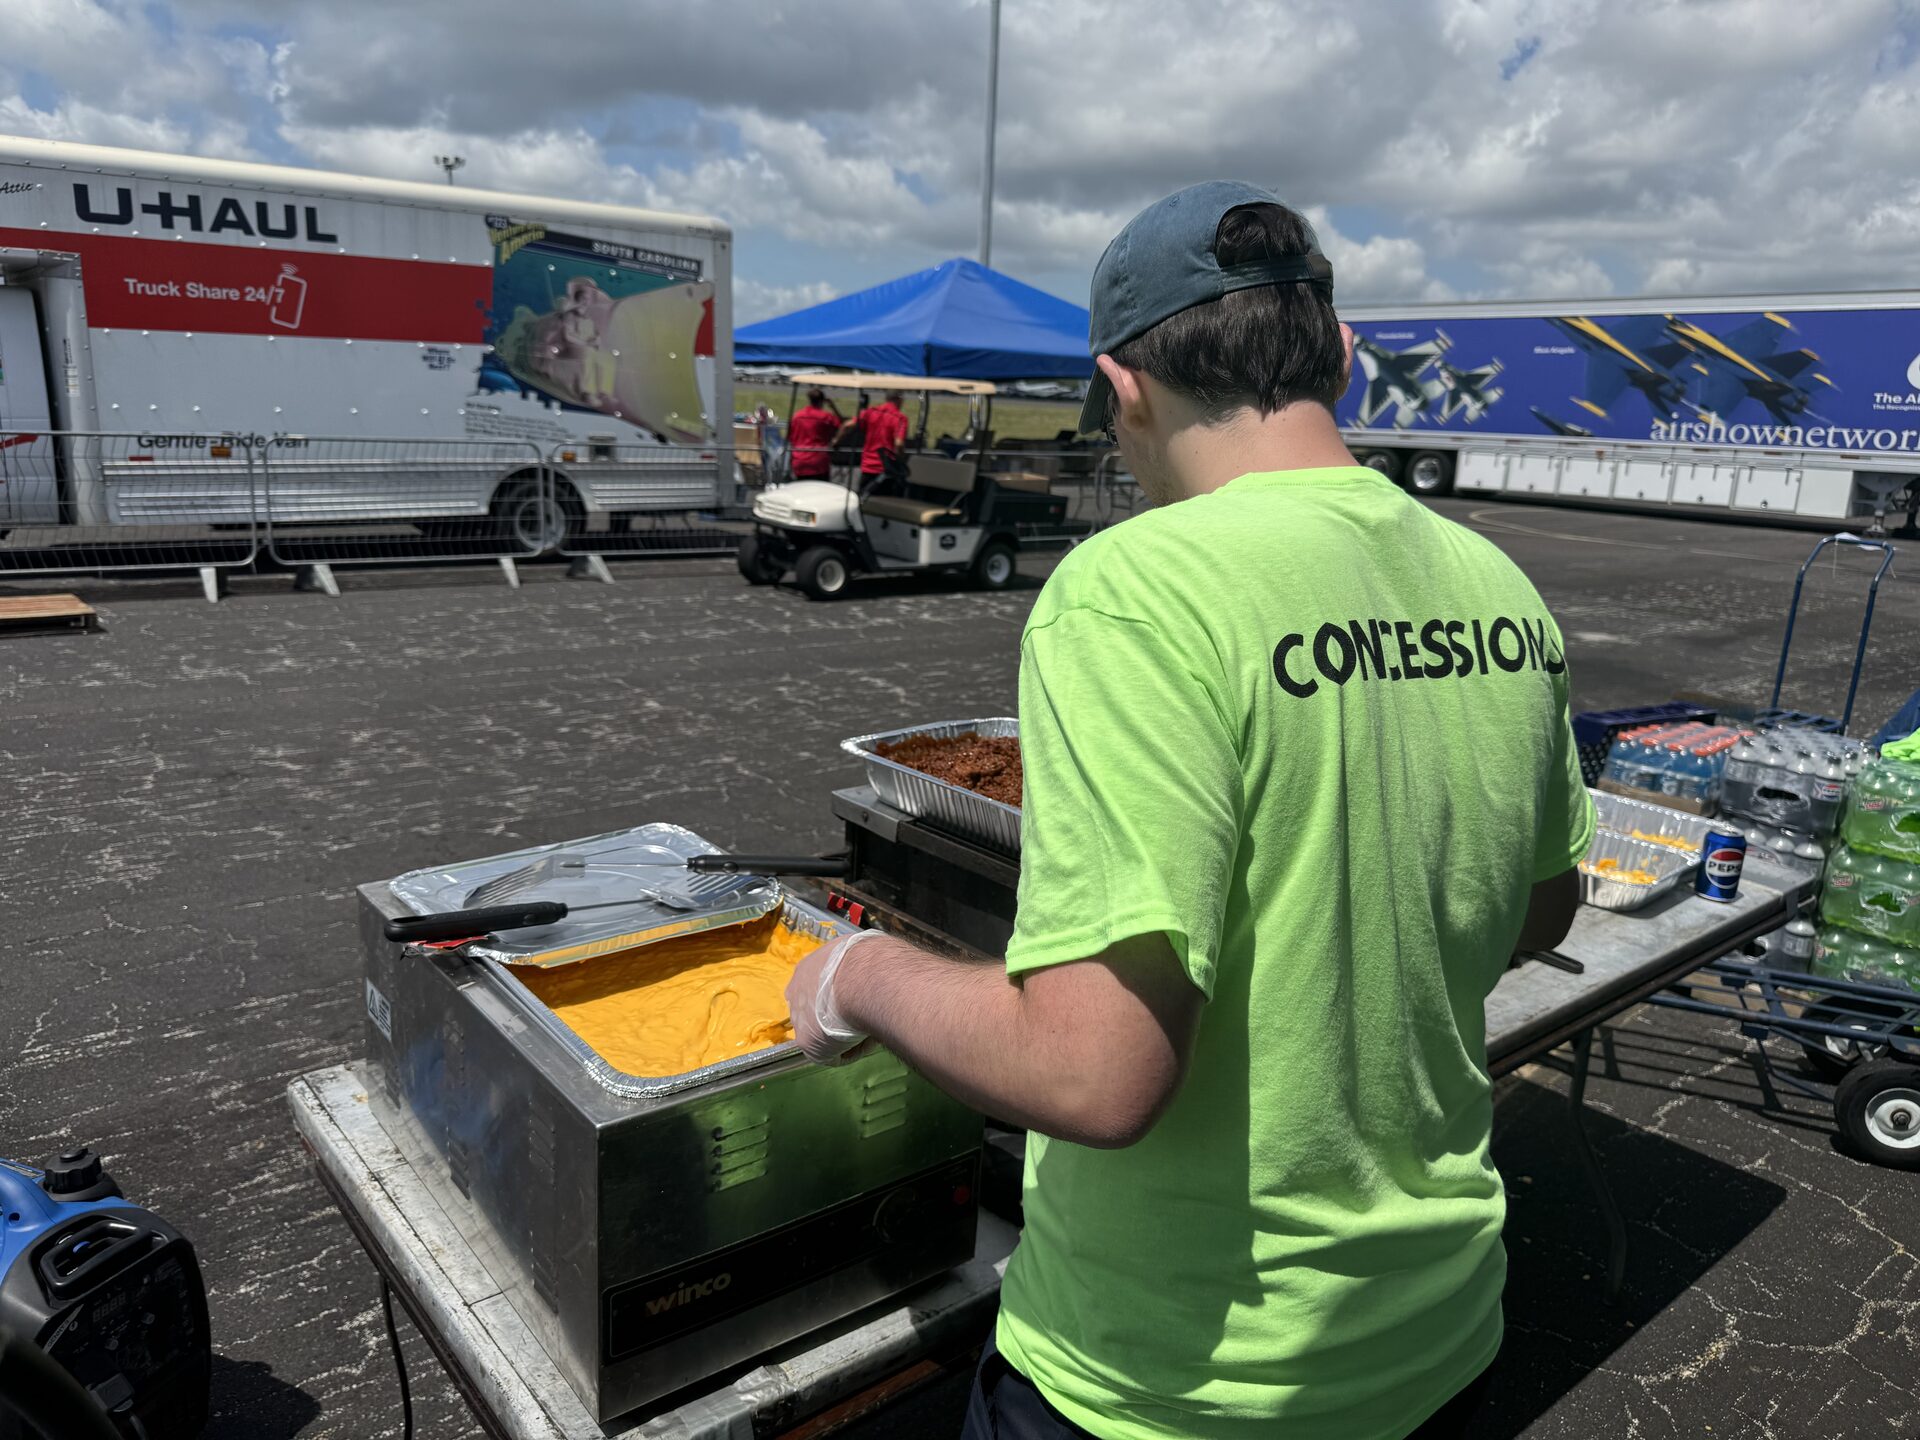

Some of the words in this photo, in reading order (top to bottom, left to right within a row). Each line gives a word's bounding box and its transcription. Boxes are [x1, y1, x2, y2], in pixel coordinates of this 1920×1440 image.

[73, 183, 338, 244] U-HAUL
[592, 241, 634, 259] SOUTH
[123, 278, 181, 297] Truck
[185, 282, 241, 300] Share
[243, 285, 285, 306] 24/7
[1873, 392, 1902, 404] The
[1649, 411, 1920, 452] airshownetwor
[644, 1271, 733, 1316] winco
